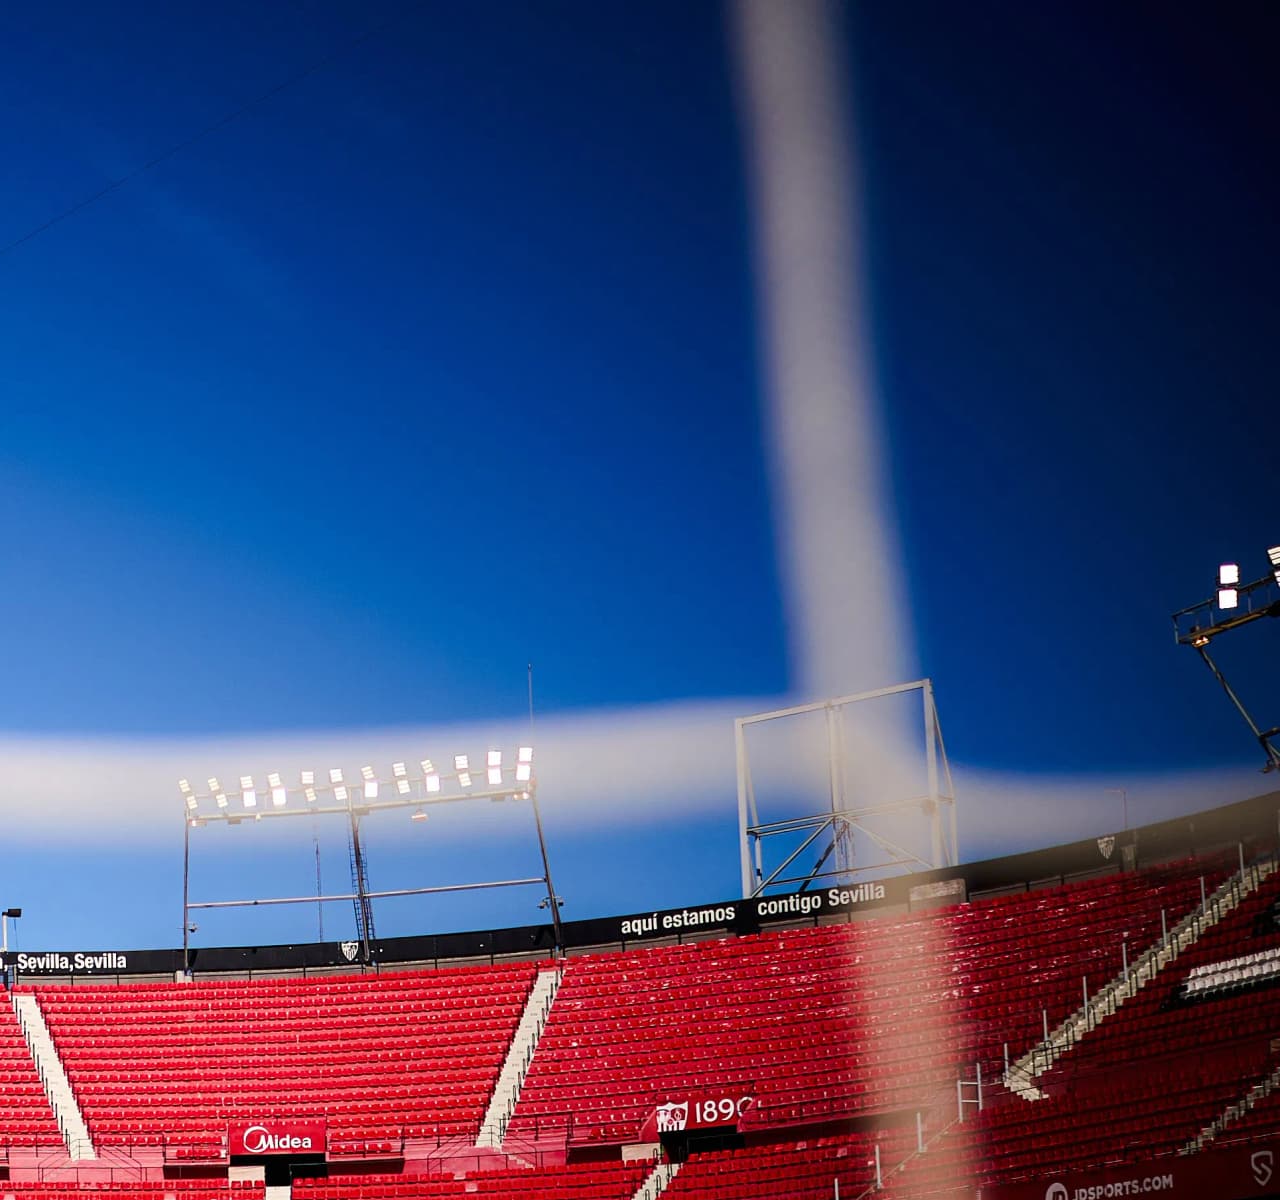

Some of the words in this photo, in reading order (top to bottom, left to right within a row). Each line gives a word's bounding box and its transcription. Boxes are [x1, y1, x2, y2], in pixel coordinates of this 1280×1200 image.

[620, 914, 658, 936] aquí
[662, 905, 736, 931] estamos
[757, 894, 822, 918] contigo
[827, 882, 886, 907] Sevilla
[249, 1130, 312, 1151] Midea
